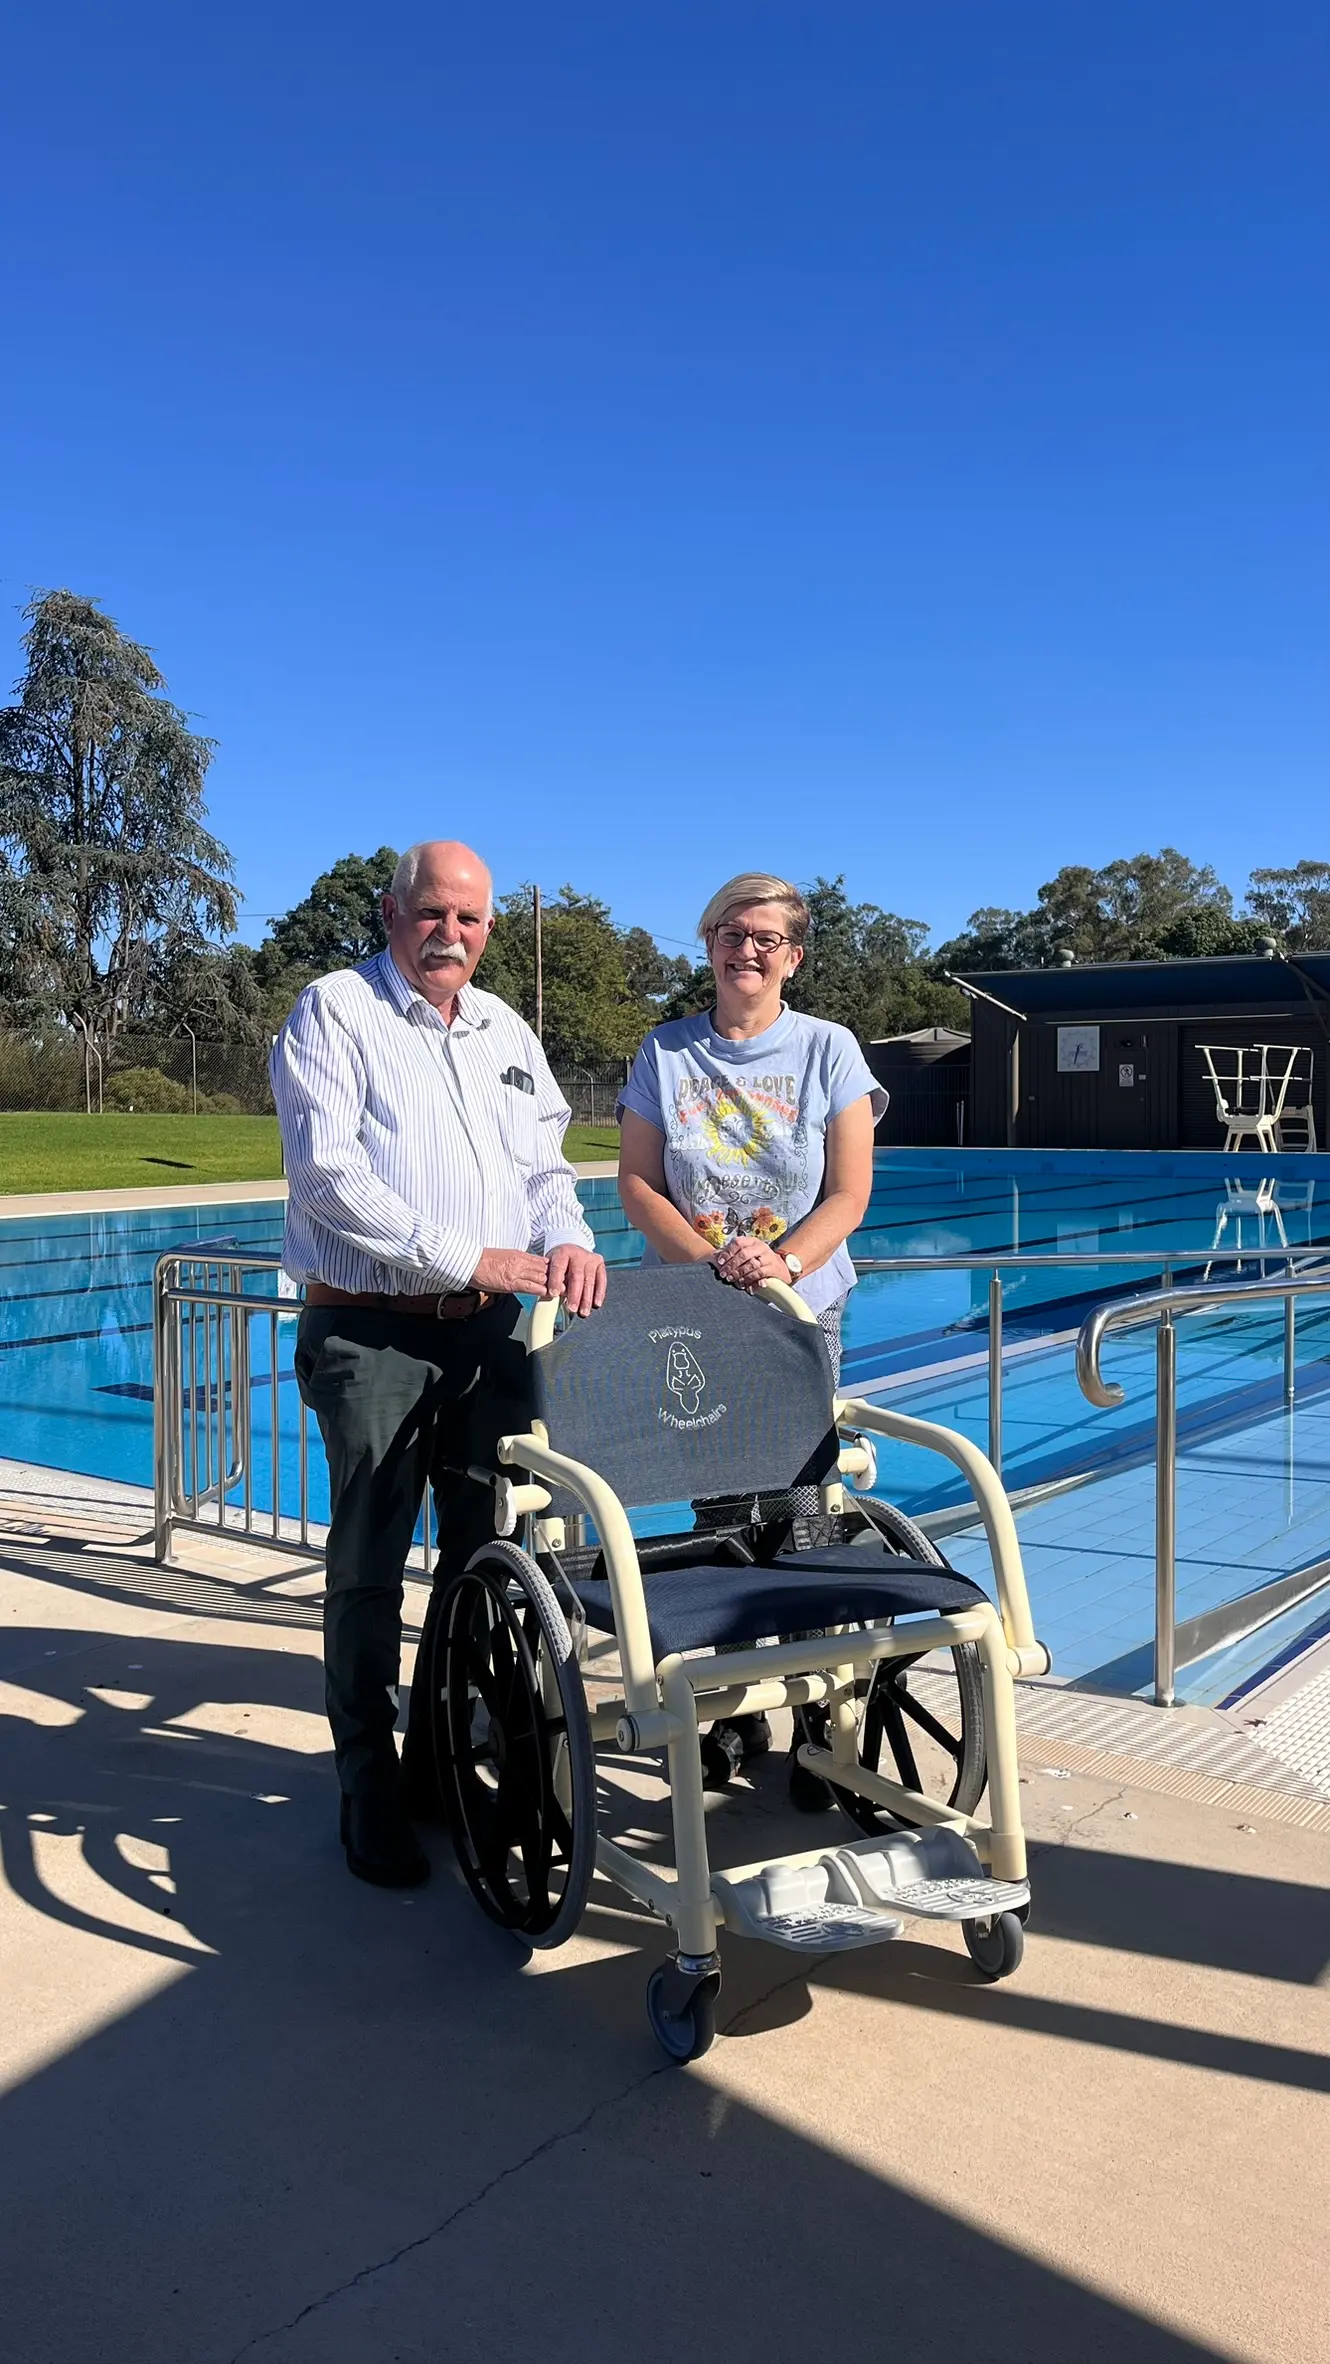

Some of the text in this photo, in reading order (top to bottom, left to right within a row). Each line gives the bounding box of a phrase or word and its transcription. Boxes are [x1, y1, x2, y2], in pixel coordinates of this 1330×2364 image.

[752, 1075, 797, 1105] LOVE
[648, 1325, 702, 1343] Platypus
[658, 1403, 727, 1430] Wheelchairs
